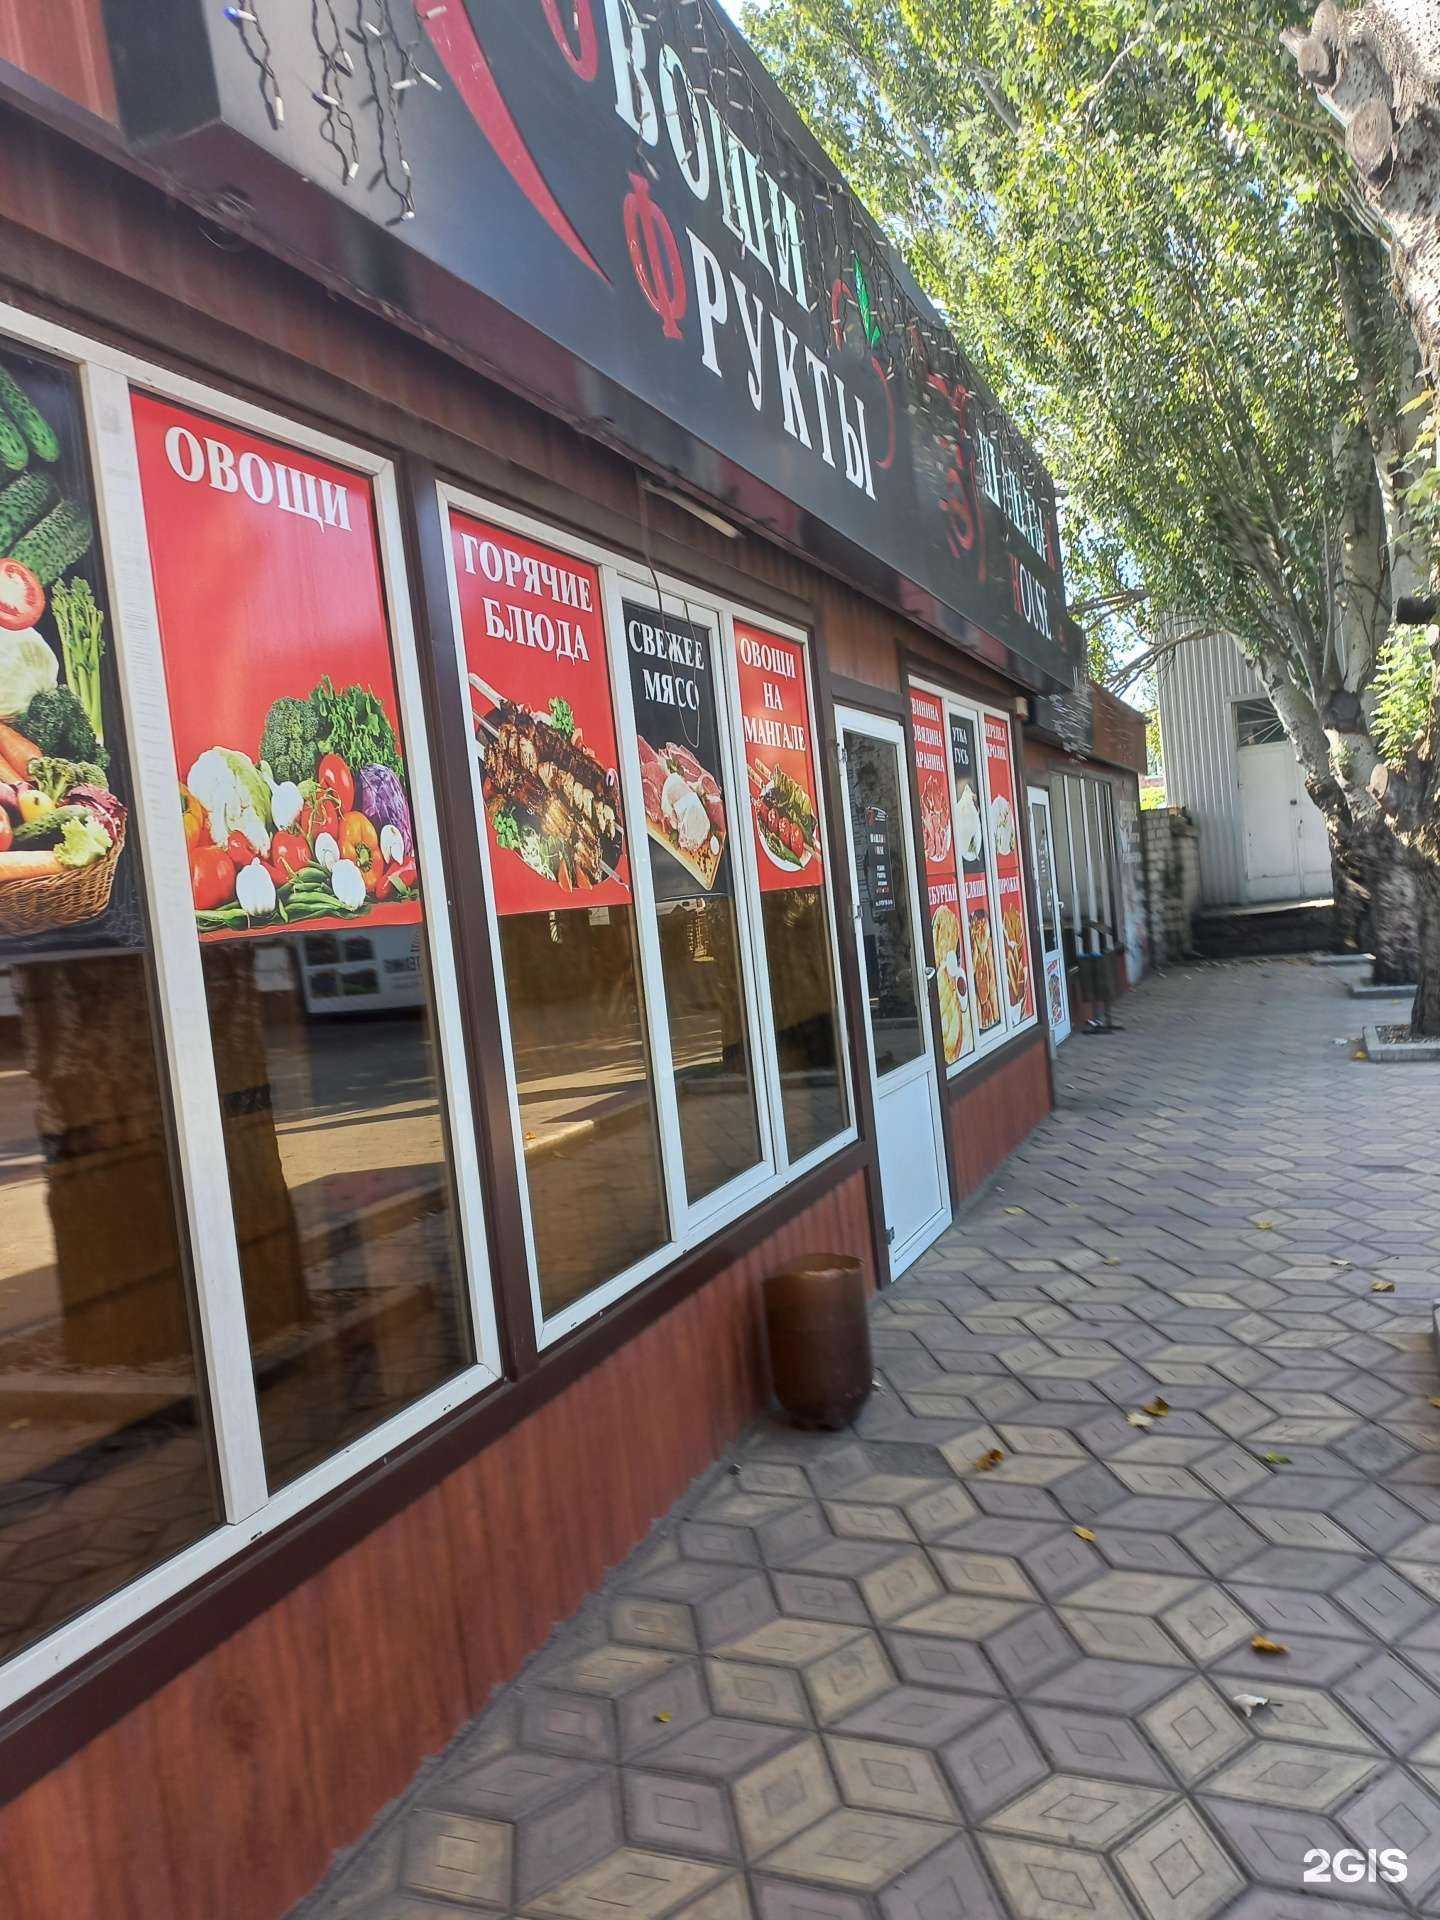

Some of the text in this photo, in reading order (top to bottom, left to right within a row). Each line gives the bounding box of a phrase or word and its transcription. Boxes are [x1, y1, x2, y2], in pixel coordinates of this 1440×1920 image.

[623, 170, 878, 502] ФРУКТЫ
[164, 426, 353, 534] ОВОЩИ
[461, 533, 593, 613] ГОРЯЧИЕ
[482, 596, 590, 665] БЛЮДА
[628, 620, 705, 671] СВЕЖЕЕ
[740, 637, 797, 681] ОВОЩИ
[642, 669, 700, 712] МЯСО
[763, 681, 784, 712] НА
[911, 697, 941, 723] ВИНИНА
[742, 714, 807, 752] МАНГАЛЕ
[951, 726, 968, 745] УТКА
[915, 750, 946, 773] АРАНИНА
[953, 747, 970, 766] ГУСЬ
